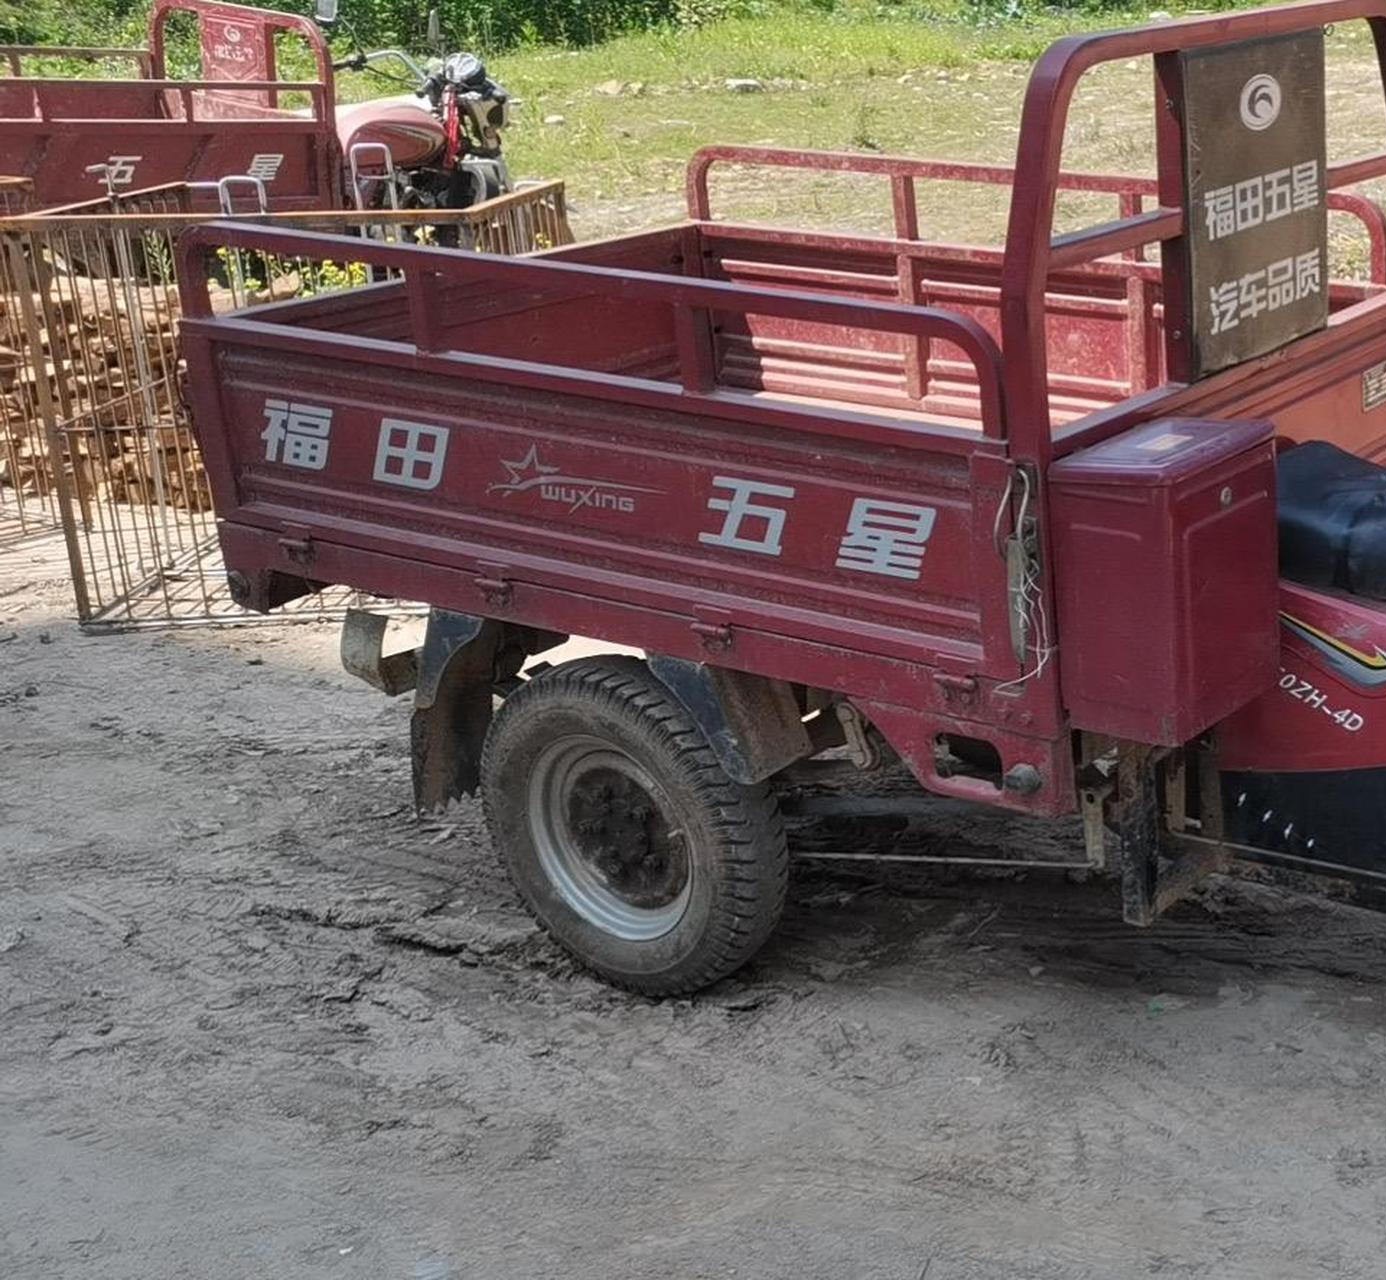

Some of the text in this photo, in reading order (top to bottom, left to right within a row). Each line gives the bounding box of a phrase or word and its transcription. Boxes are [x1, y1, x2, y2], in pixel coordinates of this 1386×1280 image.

[1204, 160, 1319, 241] 福田五星
[1209, 249, 1321, 335] 汽车品质
[261, 400, 450, 490] 福田
[698, 475, 937, 580] 五星
[1279, 667, 1364, 732] 0ZH-4D
